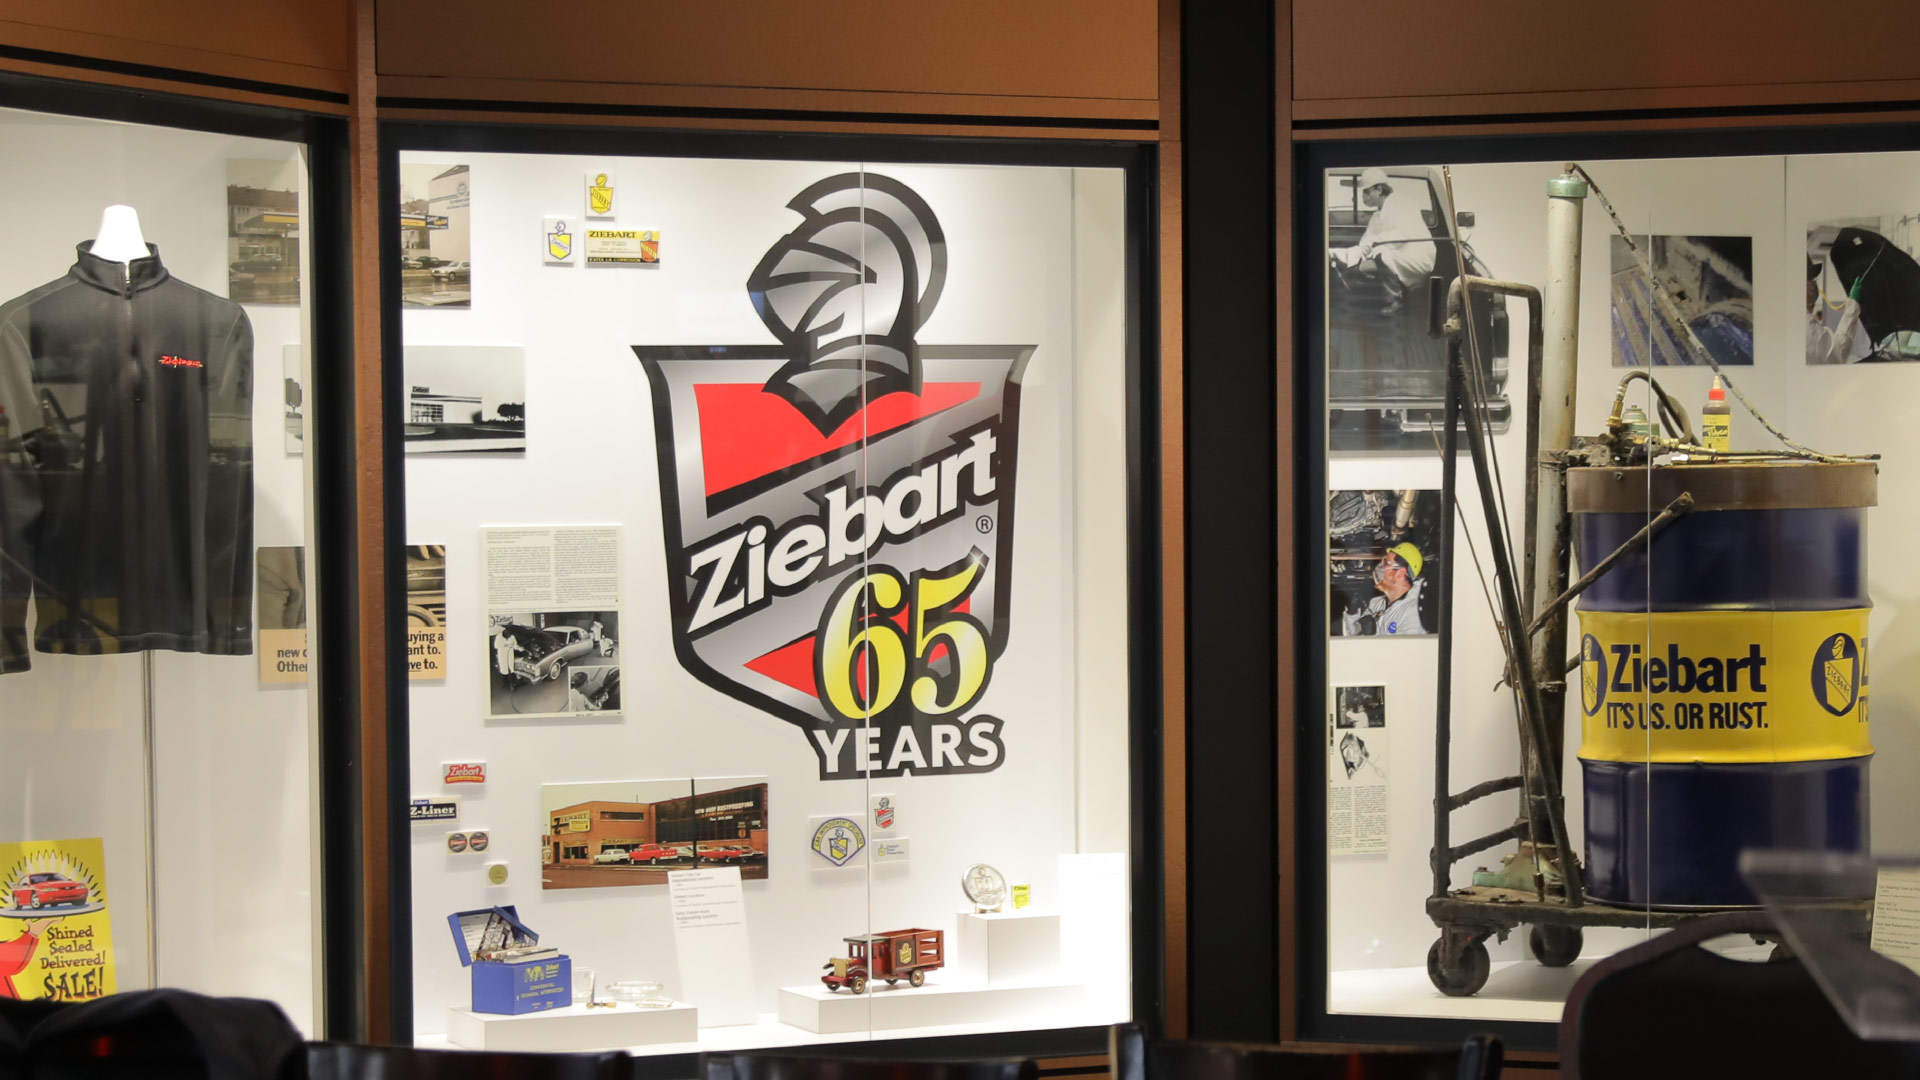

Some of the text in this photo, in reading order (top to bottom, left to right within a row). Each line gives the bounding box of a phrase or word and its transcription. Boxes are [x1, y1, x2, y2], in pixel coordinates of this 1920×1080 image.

[588, 230, 637, 239] ZIEBART
[687, 428, 997, 634] Ziebart
[437, 633, 445, 641] a
[822, 556, 989, 720] 65
[277, 649, 301, 658] new
[427, 644, 442, 655] to.
[423, 658, 439, 670] to.
[1610, 643, 1767, 693] Ziebart
[1606, 701, 1769, 730] IT'S US. OR RUST.
[812, 721, 998, 774] YEARS
[450, 765, 481, 776] Ziebart
[410, 805, 455, 815] Z-Liner
[46, 924, 95, 941] Shined
[49, 939, 94, 956] Sealed
[40, 949, 106, 970] Delivered!
[43, 966, 104, 1000] SALE!
